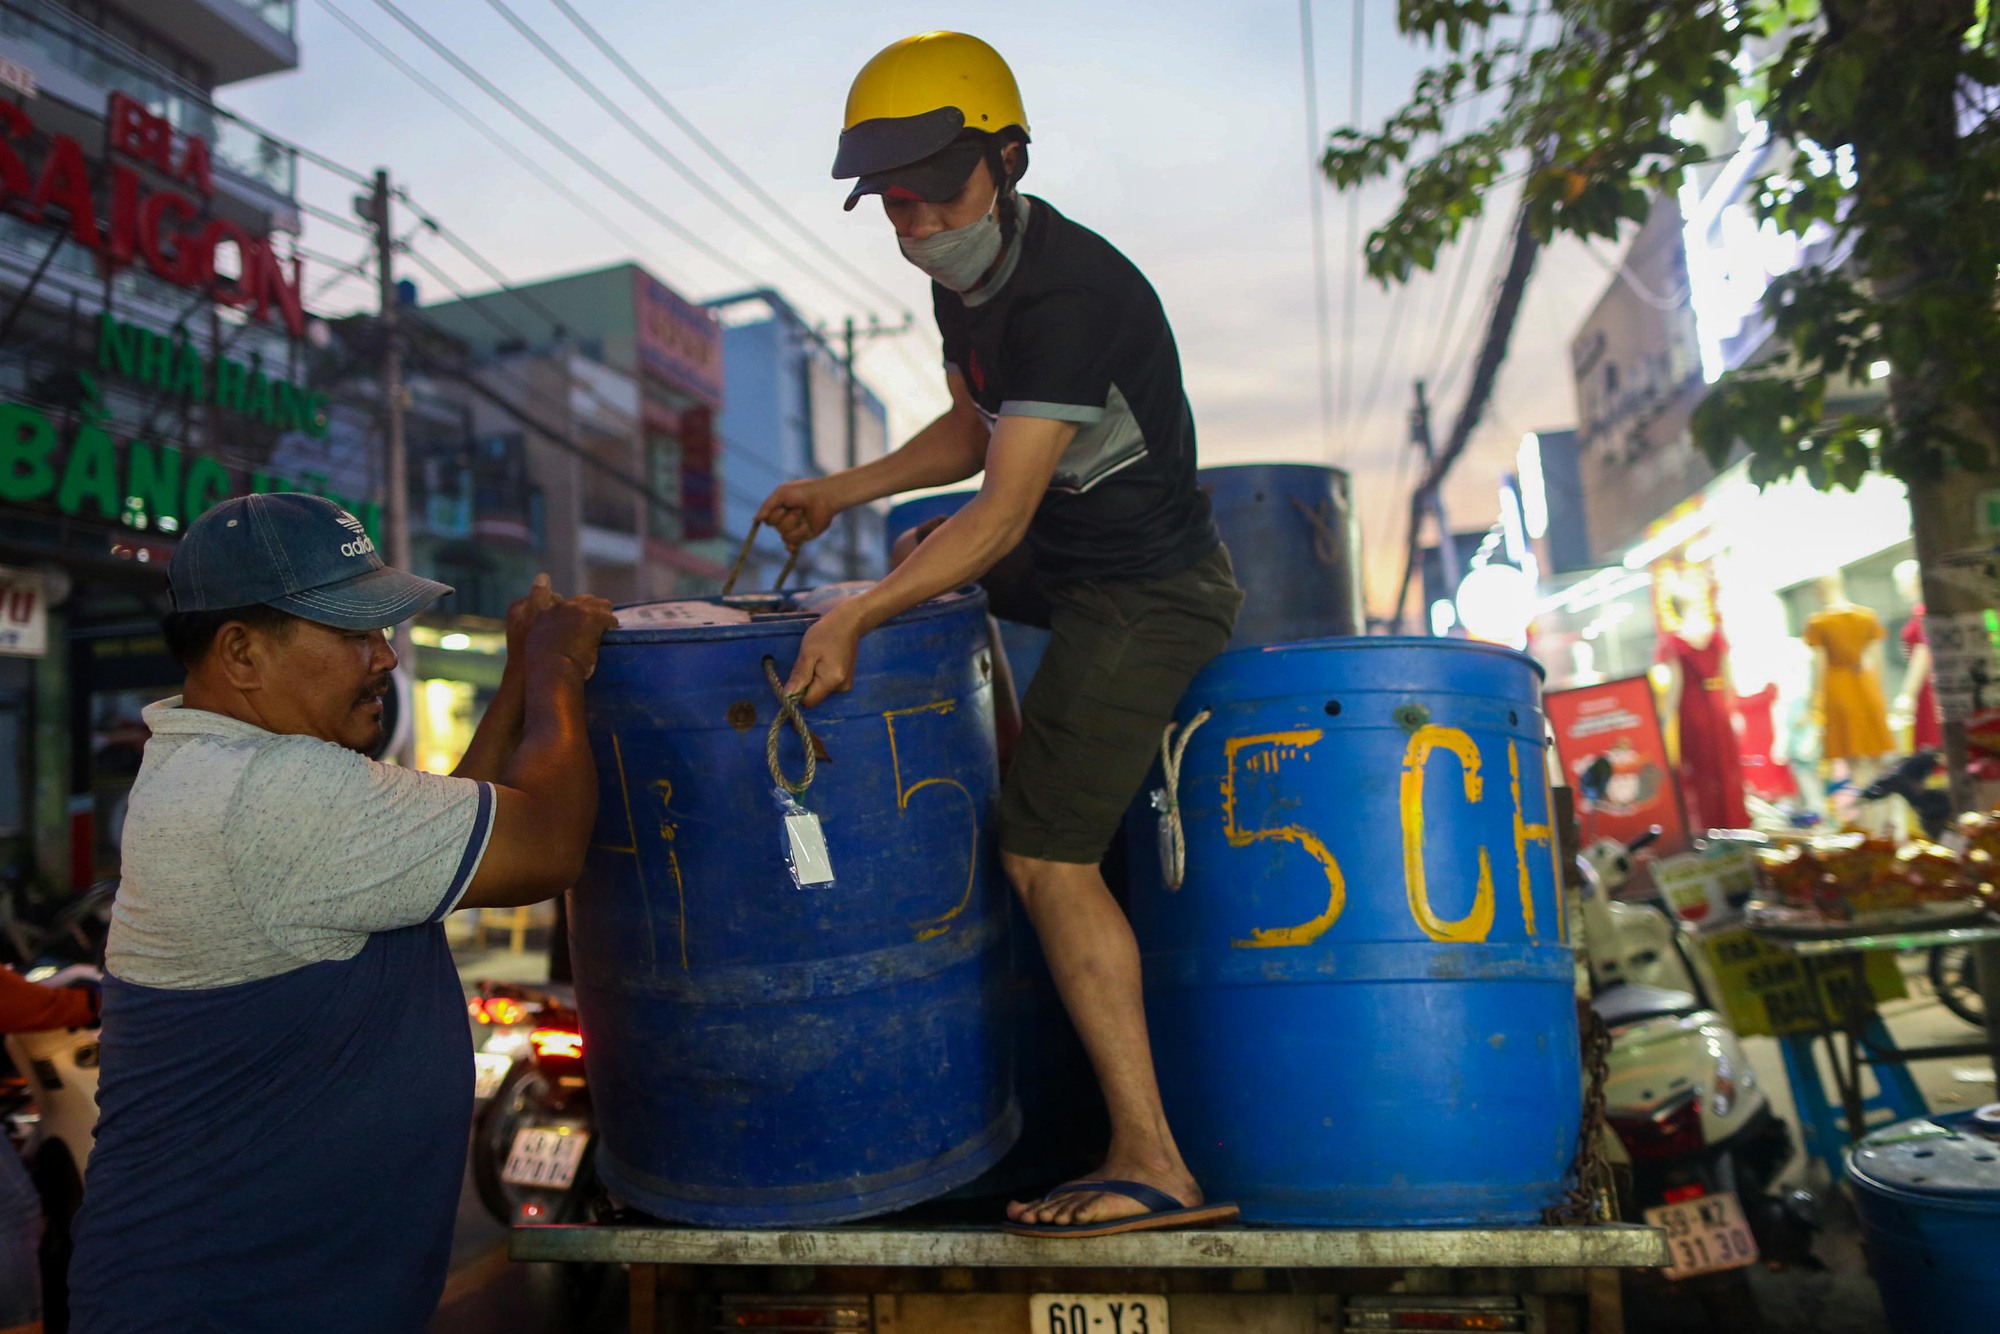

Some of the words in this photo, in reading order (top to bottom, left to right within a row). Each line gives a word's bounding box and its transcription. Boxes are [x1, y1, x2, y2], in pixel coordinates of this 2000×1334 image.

[108, 90, 213, 194] BIA
[1220, 722, 1346, 949] 5
[1049, 1302, 1149, 1334] 60-Y3
